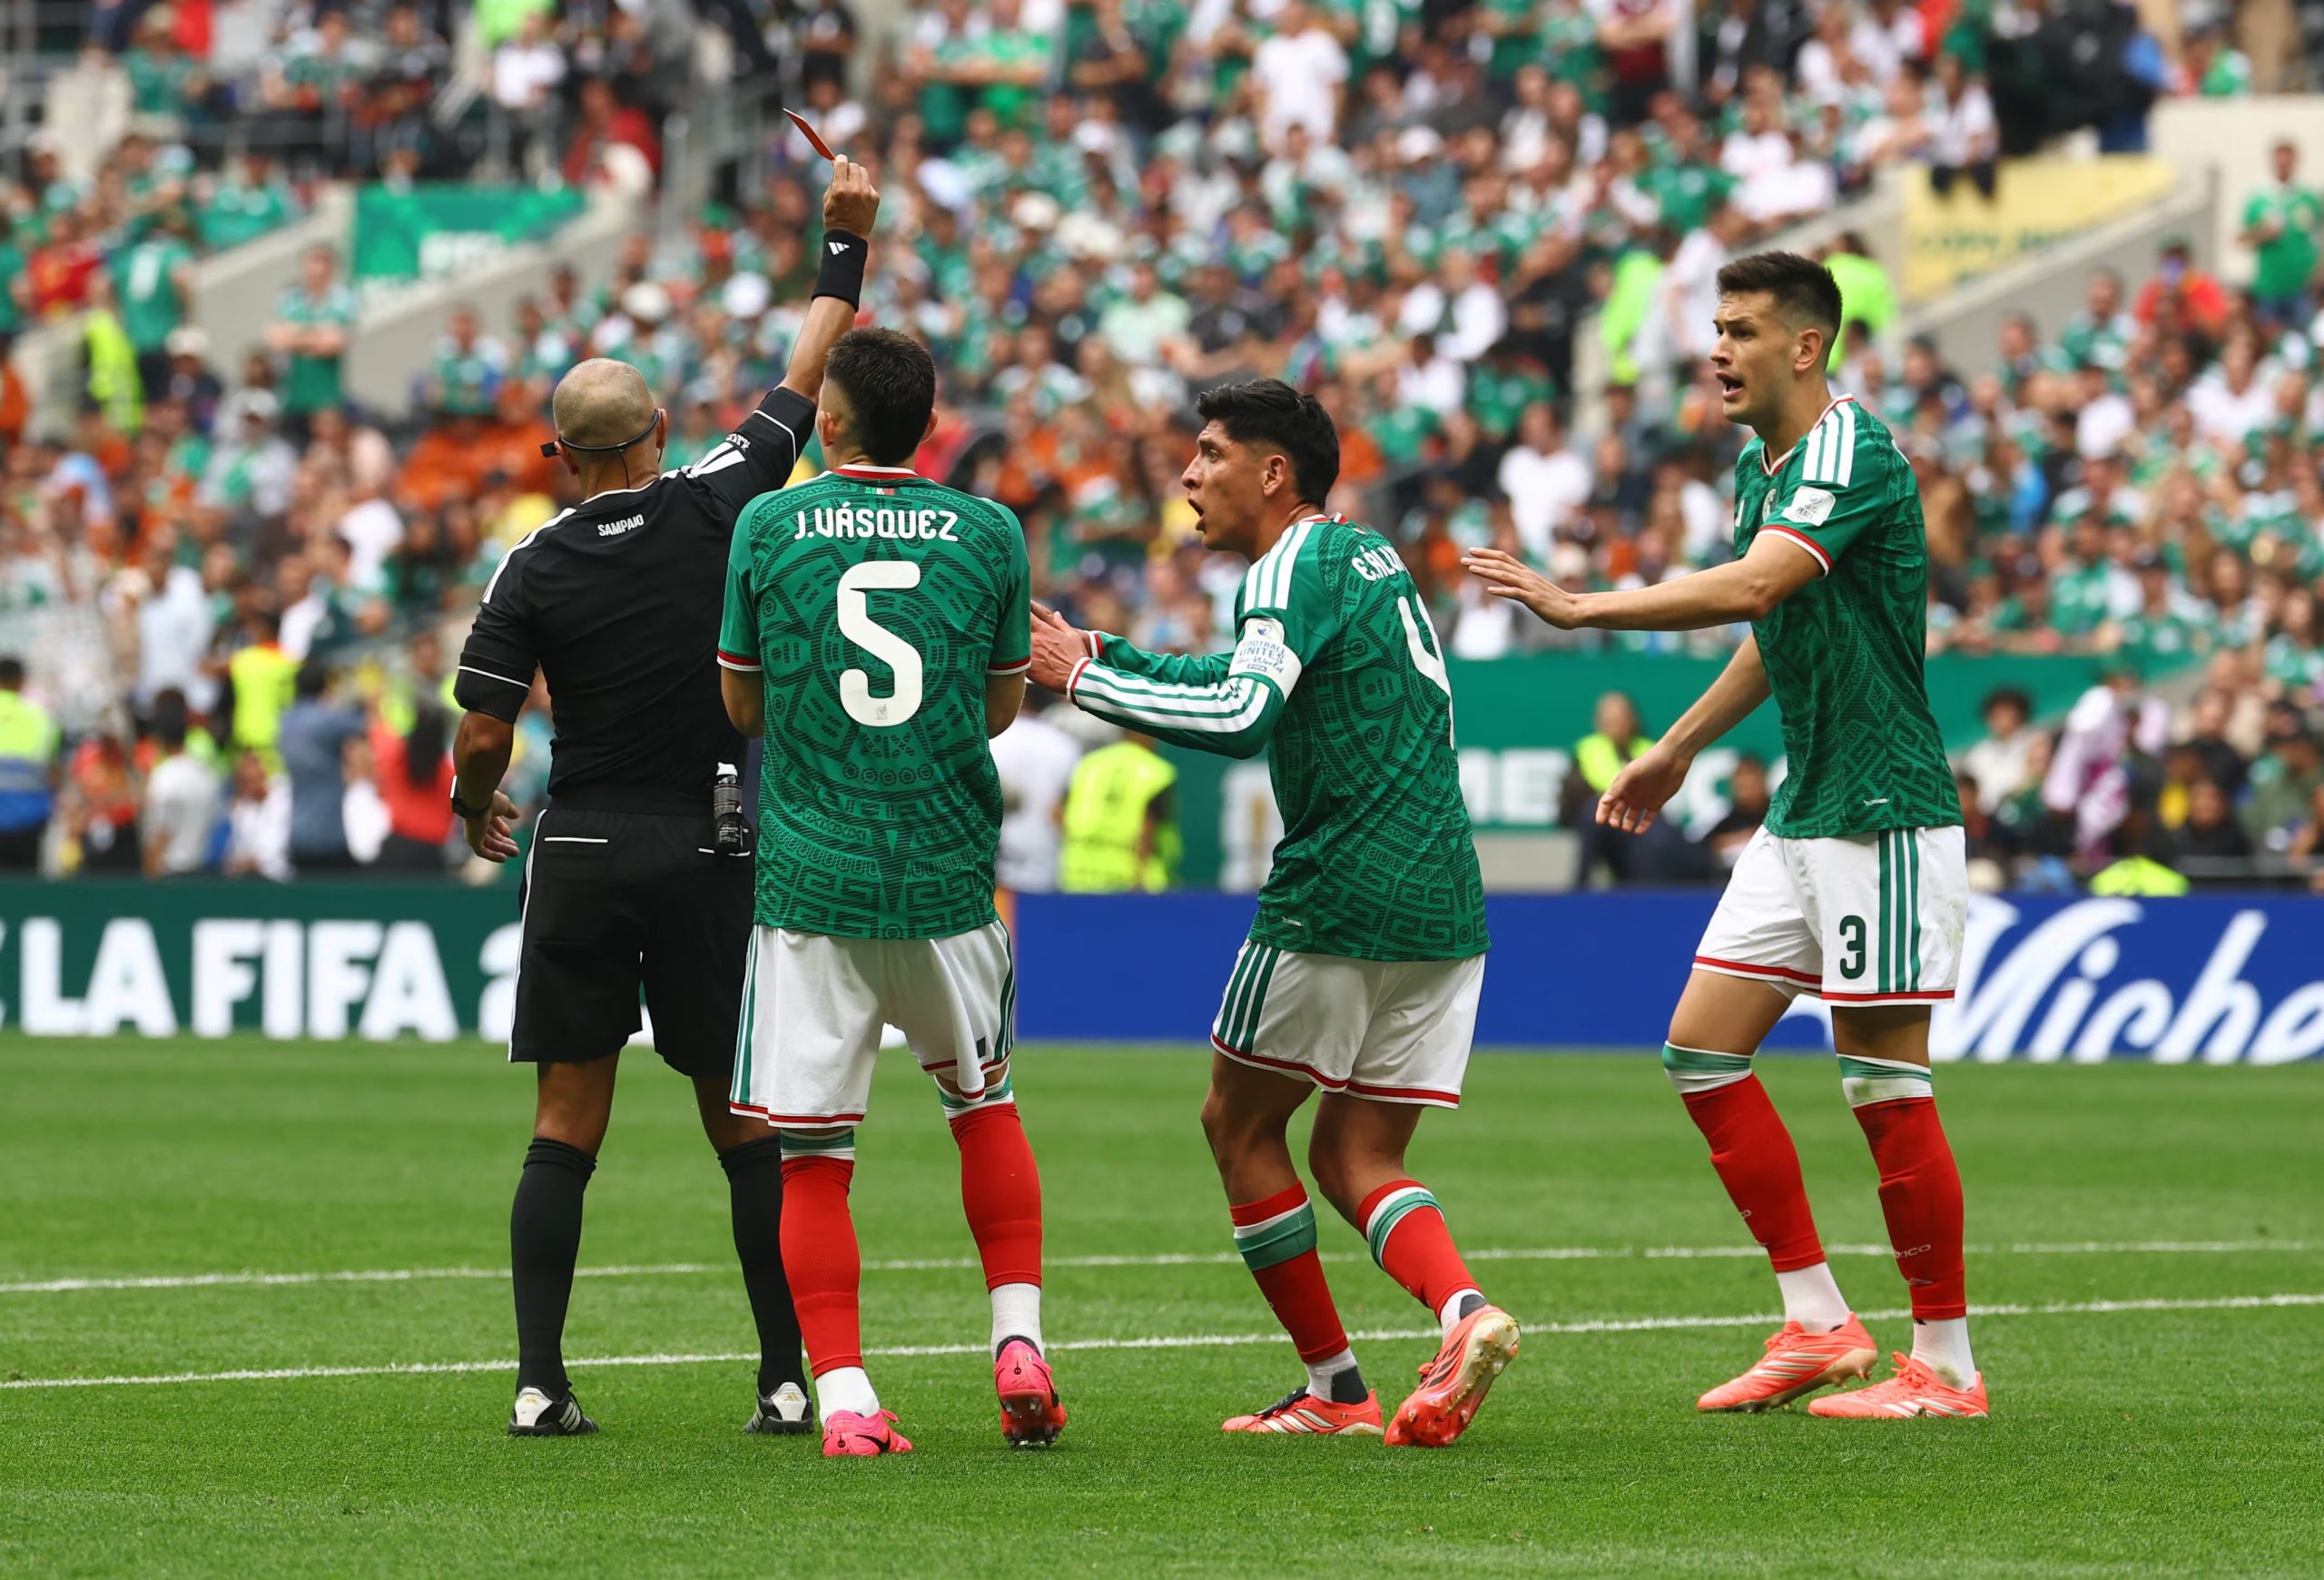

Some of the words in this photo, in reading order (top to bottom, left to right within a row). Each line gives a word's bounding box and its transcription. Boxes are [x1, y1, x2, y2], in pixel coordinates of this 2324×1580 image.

[597, 514, 645, 537] SAMPAIO
[794, 501, 959, 542] J.VÁSQUEZ
[837, 560, 922, 726] 5
[1239, 647, 1285, 664] UNITES
[1839, 914, 1866, 980] 3
[20, 917, 177, 1037] LA
[192, 918, 459, 1042] FIFA
